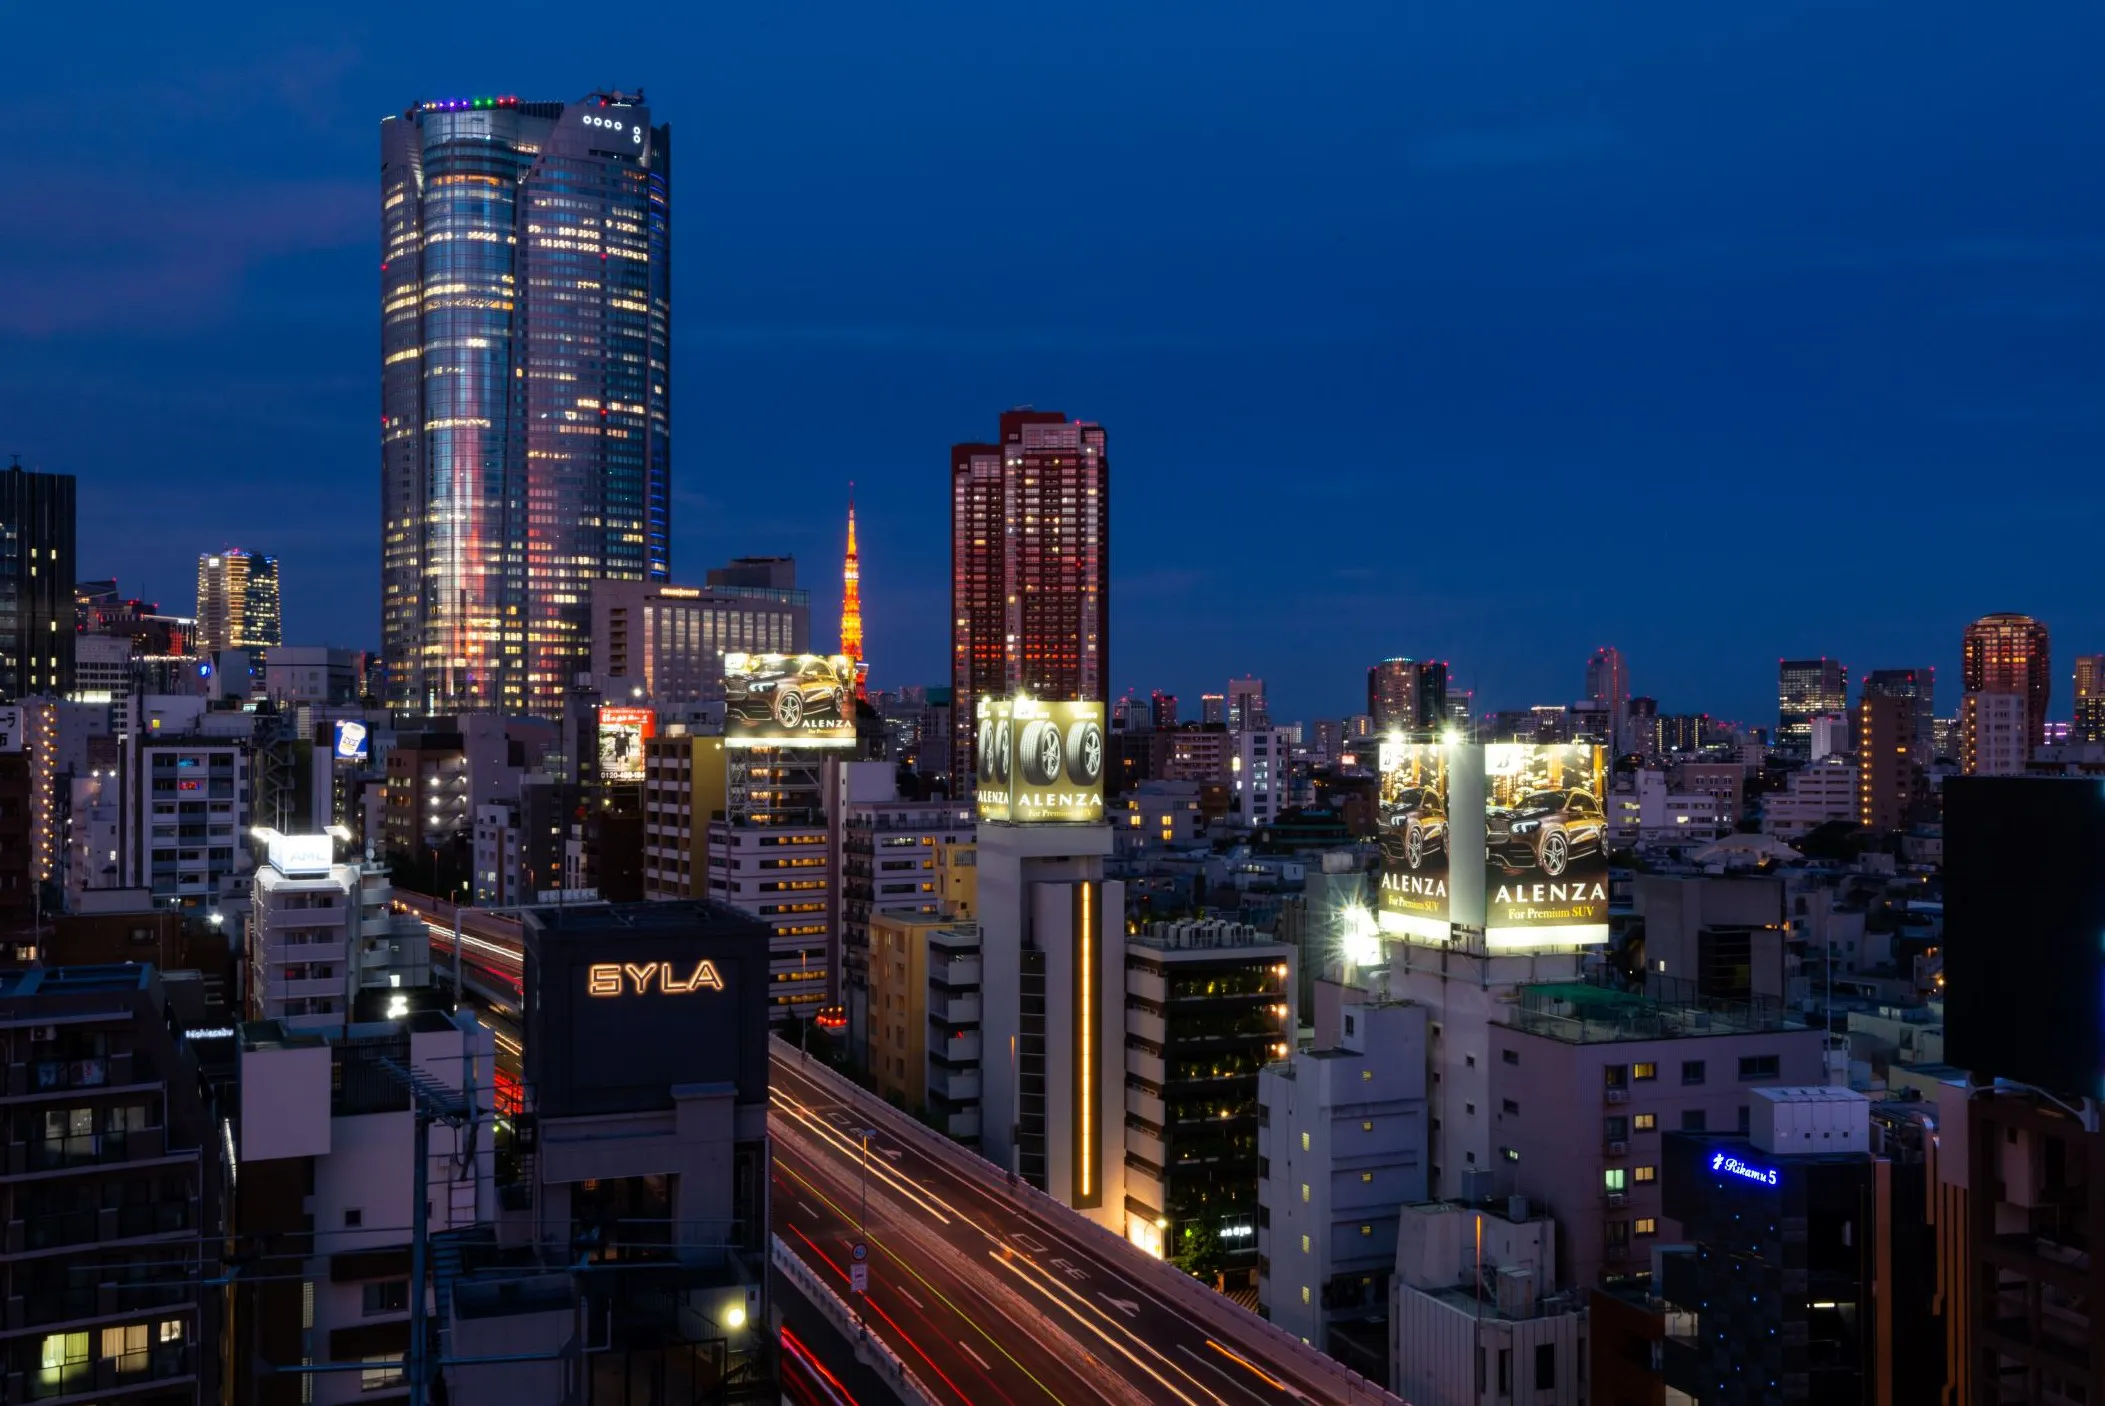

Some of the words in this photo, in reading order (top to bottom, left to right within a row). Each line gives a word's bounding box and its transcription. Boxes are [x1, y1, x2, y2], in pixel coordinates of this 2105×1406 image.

[802, 719, 852, 728] ALENZA
[977, 790, 1009, 805] ALENZA
[1018, 793, 1102, 806] ALENZA
[1381, 872, 1447, 897] ALENZA
[1495, 882, 1606, 903] ALENZA
[1388, 894, 1398, 906] For
[1424, 900, 1439, 912] SUV
[1508, 908, 1525, 920] For
[1527, 906, 1570, 919] Premium
[1572, 905, 1595, 918] SUV
[589, 960, 724, 996] SYLA
[1724, 1158, 1767, 1182] Rikamu
[1768, 1169, 1777, 1185] 5
